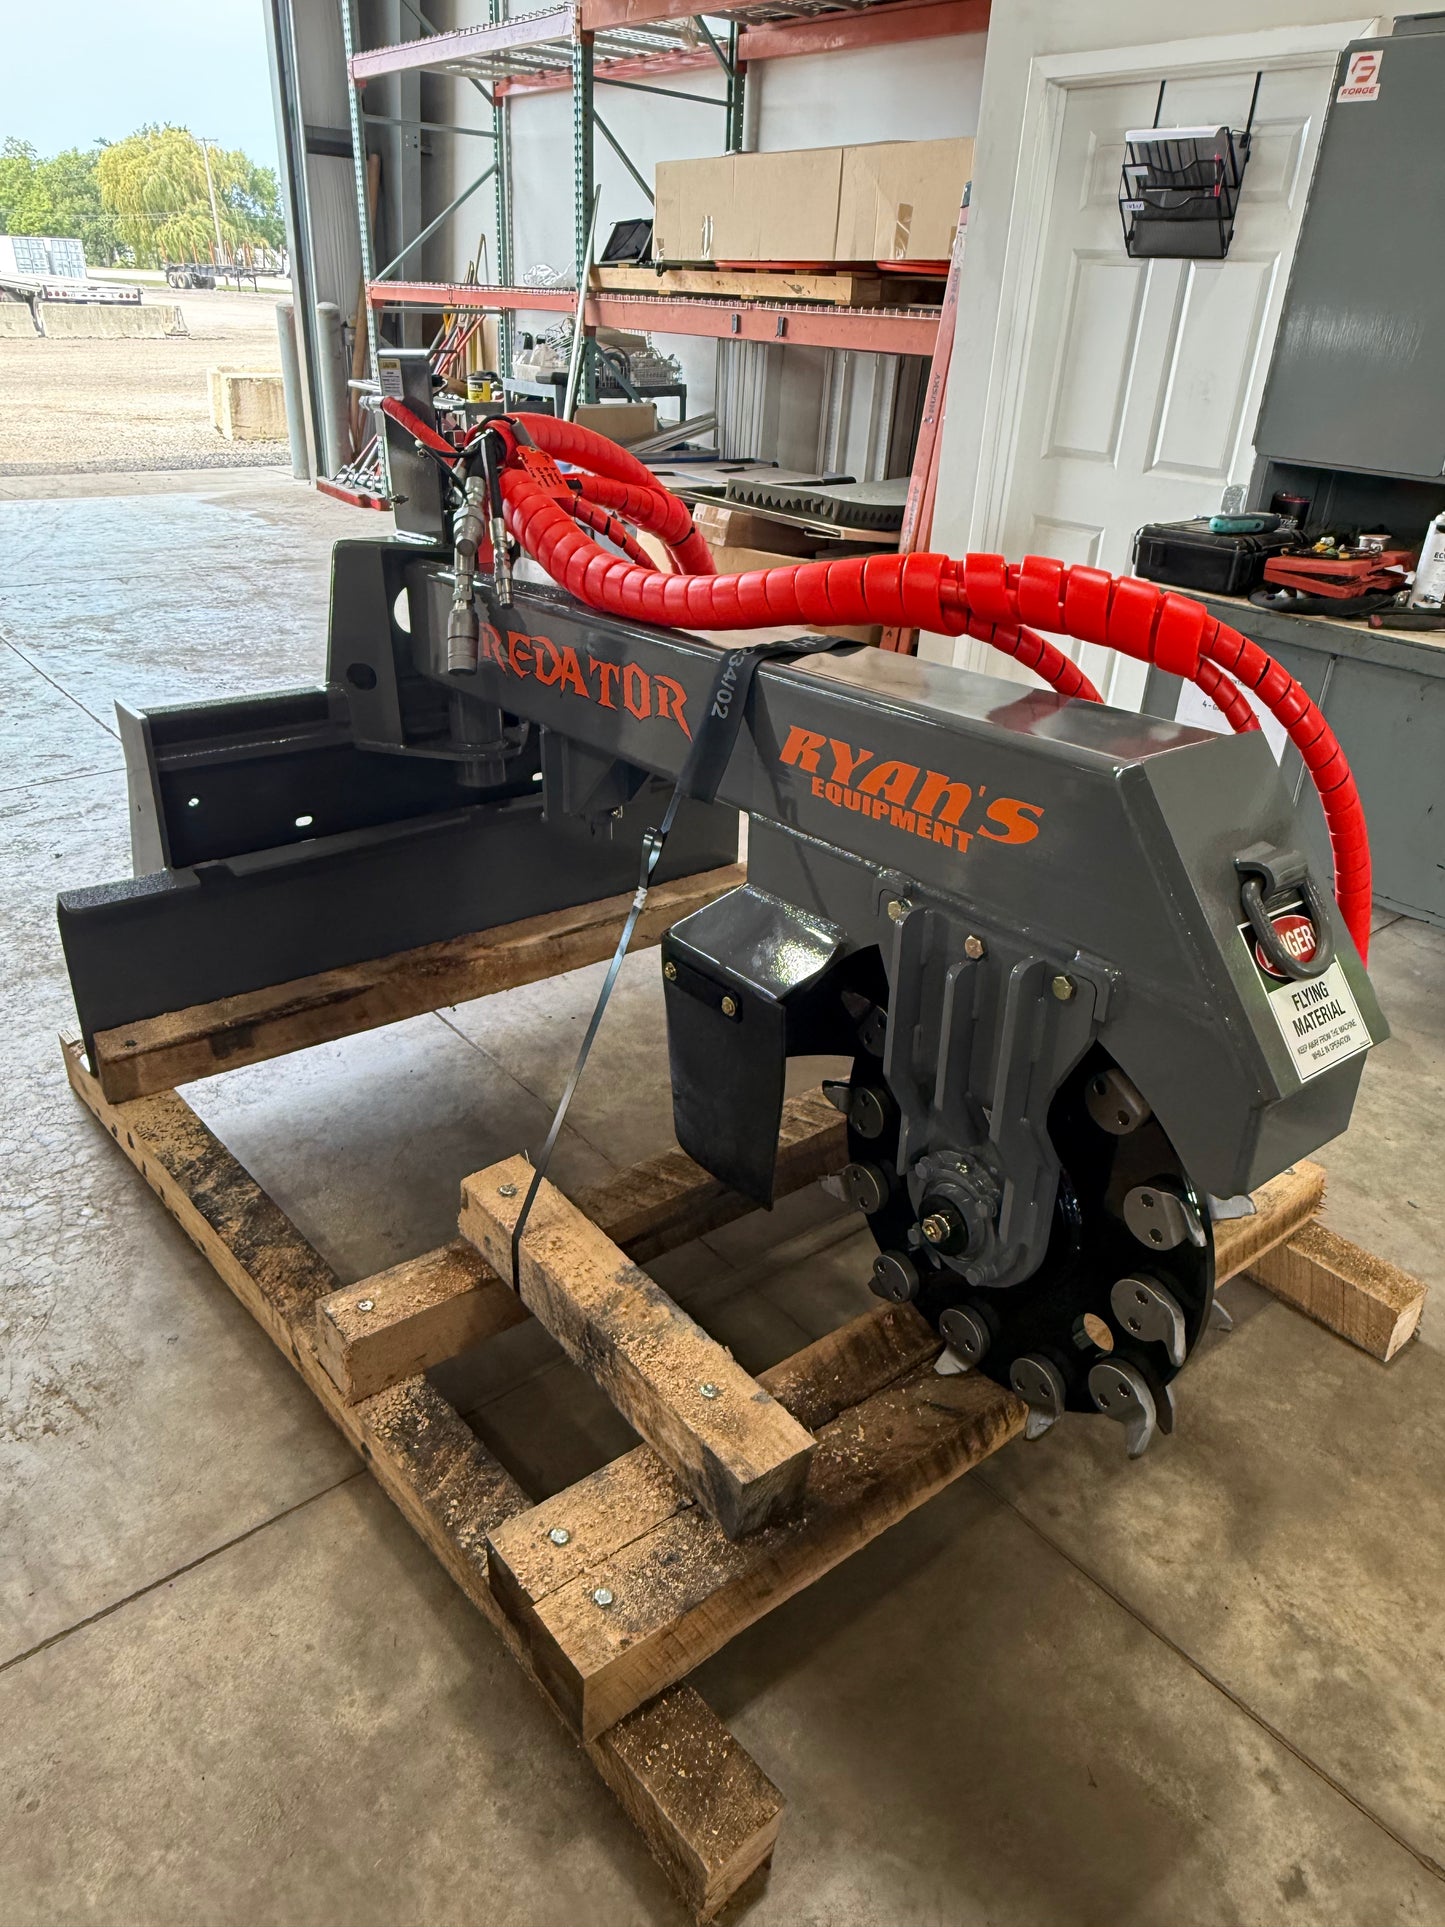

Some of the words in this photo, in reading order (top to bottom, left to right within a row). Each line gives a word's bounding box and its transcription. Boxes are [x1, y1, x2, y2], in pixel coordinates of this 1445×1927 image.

[1341, 86, 1377, 96] FORGE
[480, 621, 694, 744] REDATOR
[778, 724, 1046, 845] RYAN'S
[811, 776, 974, 854] EQUIPMENT
[1291, 981, 1330, 1012] FLYING
[1292, 998, 1346, 1038] MATERIAL
[1297, 1043, 1308, 1055] KEEP
[1319, 1032, 1332, 1044] FROM
[1330, 1027, 1340, 1038] THE
[1338, 1019, 1357, 1034] MACHINE
[1311, 1049, 1326, 1060] WHILE
[1329, 1034, 1352, 1051] OPERATION
